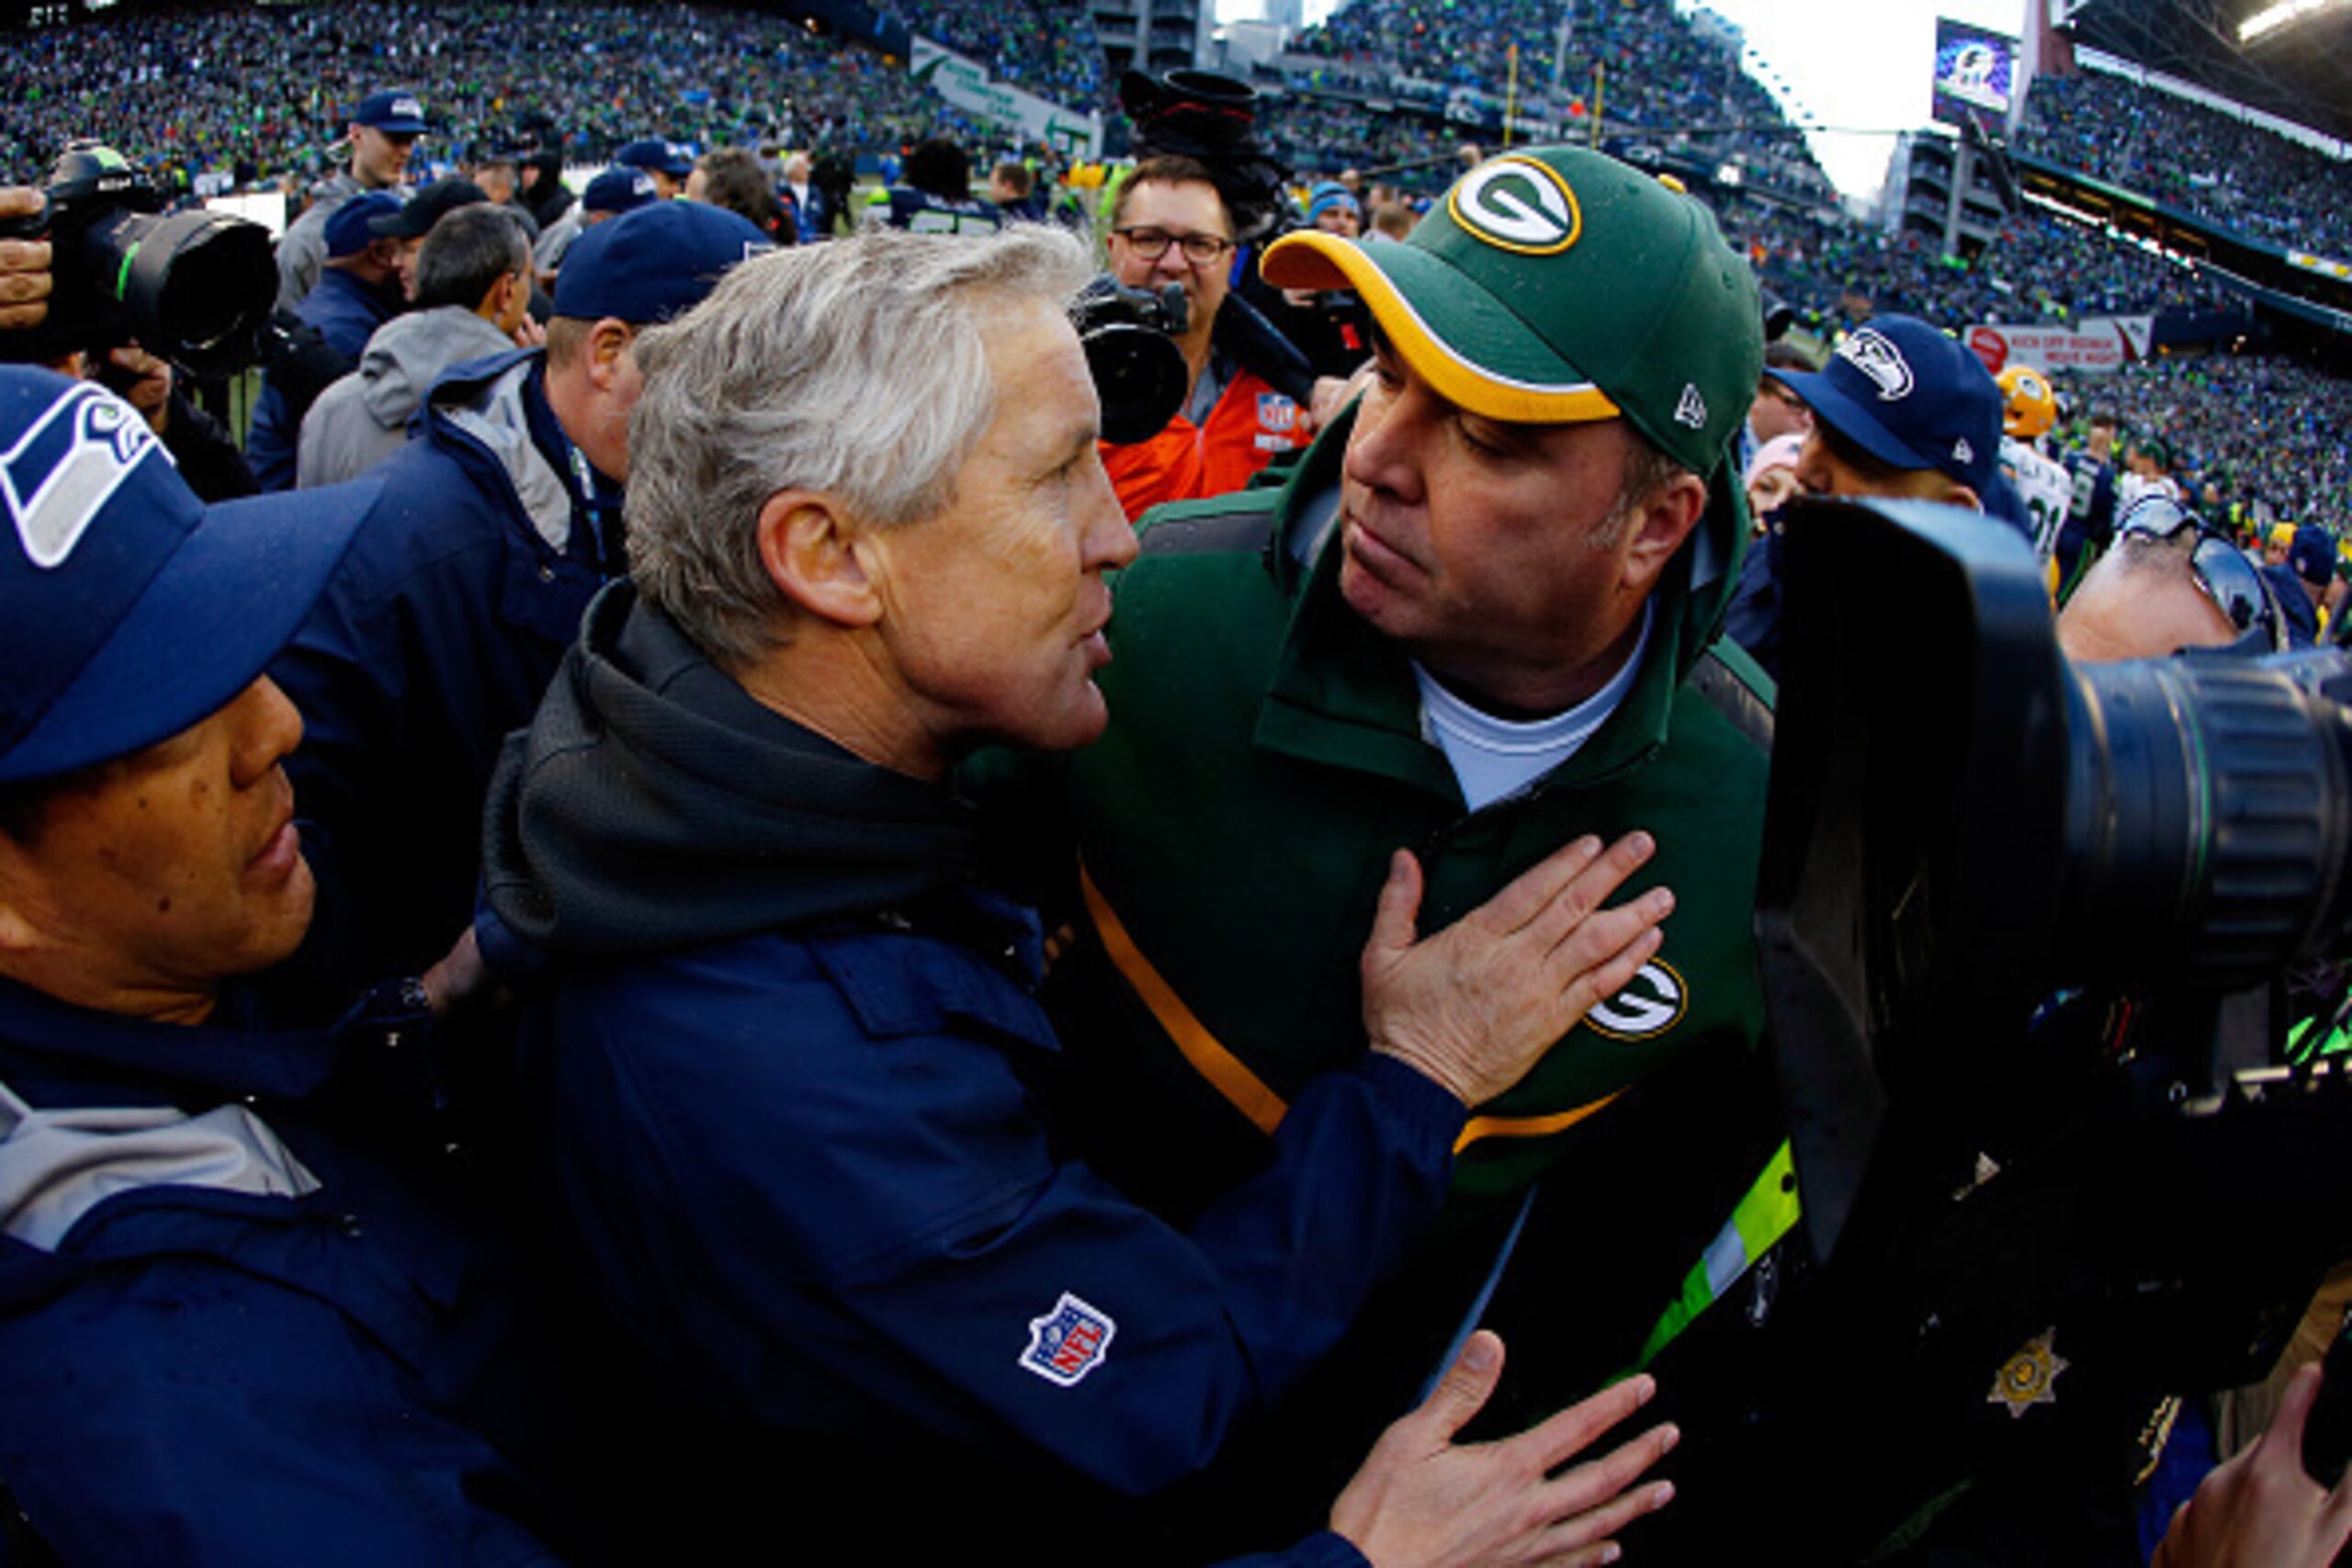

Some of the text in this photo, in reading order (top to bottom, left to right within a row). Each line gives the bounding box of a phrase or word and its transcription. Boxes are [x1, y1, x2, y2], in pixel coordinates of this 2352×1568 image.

[1457, 162, 1570, 243] G
[1263, 404, 1295, 425] NFL
[1051, 1321, 1102, 1374] NFL
